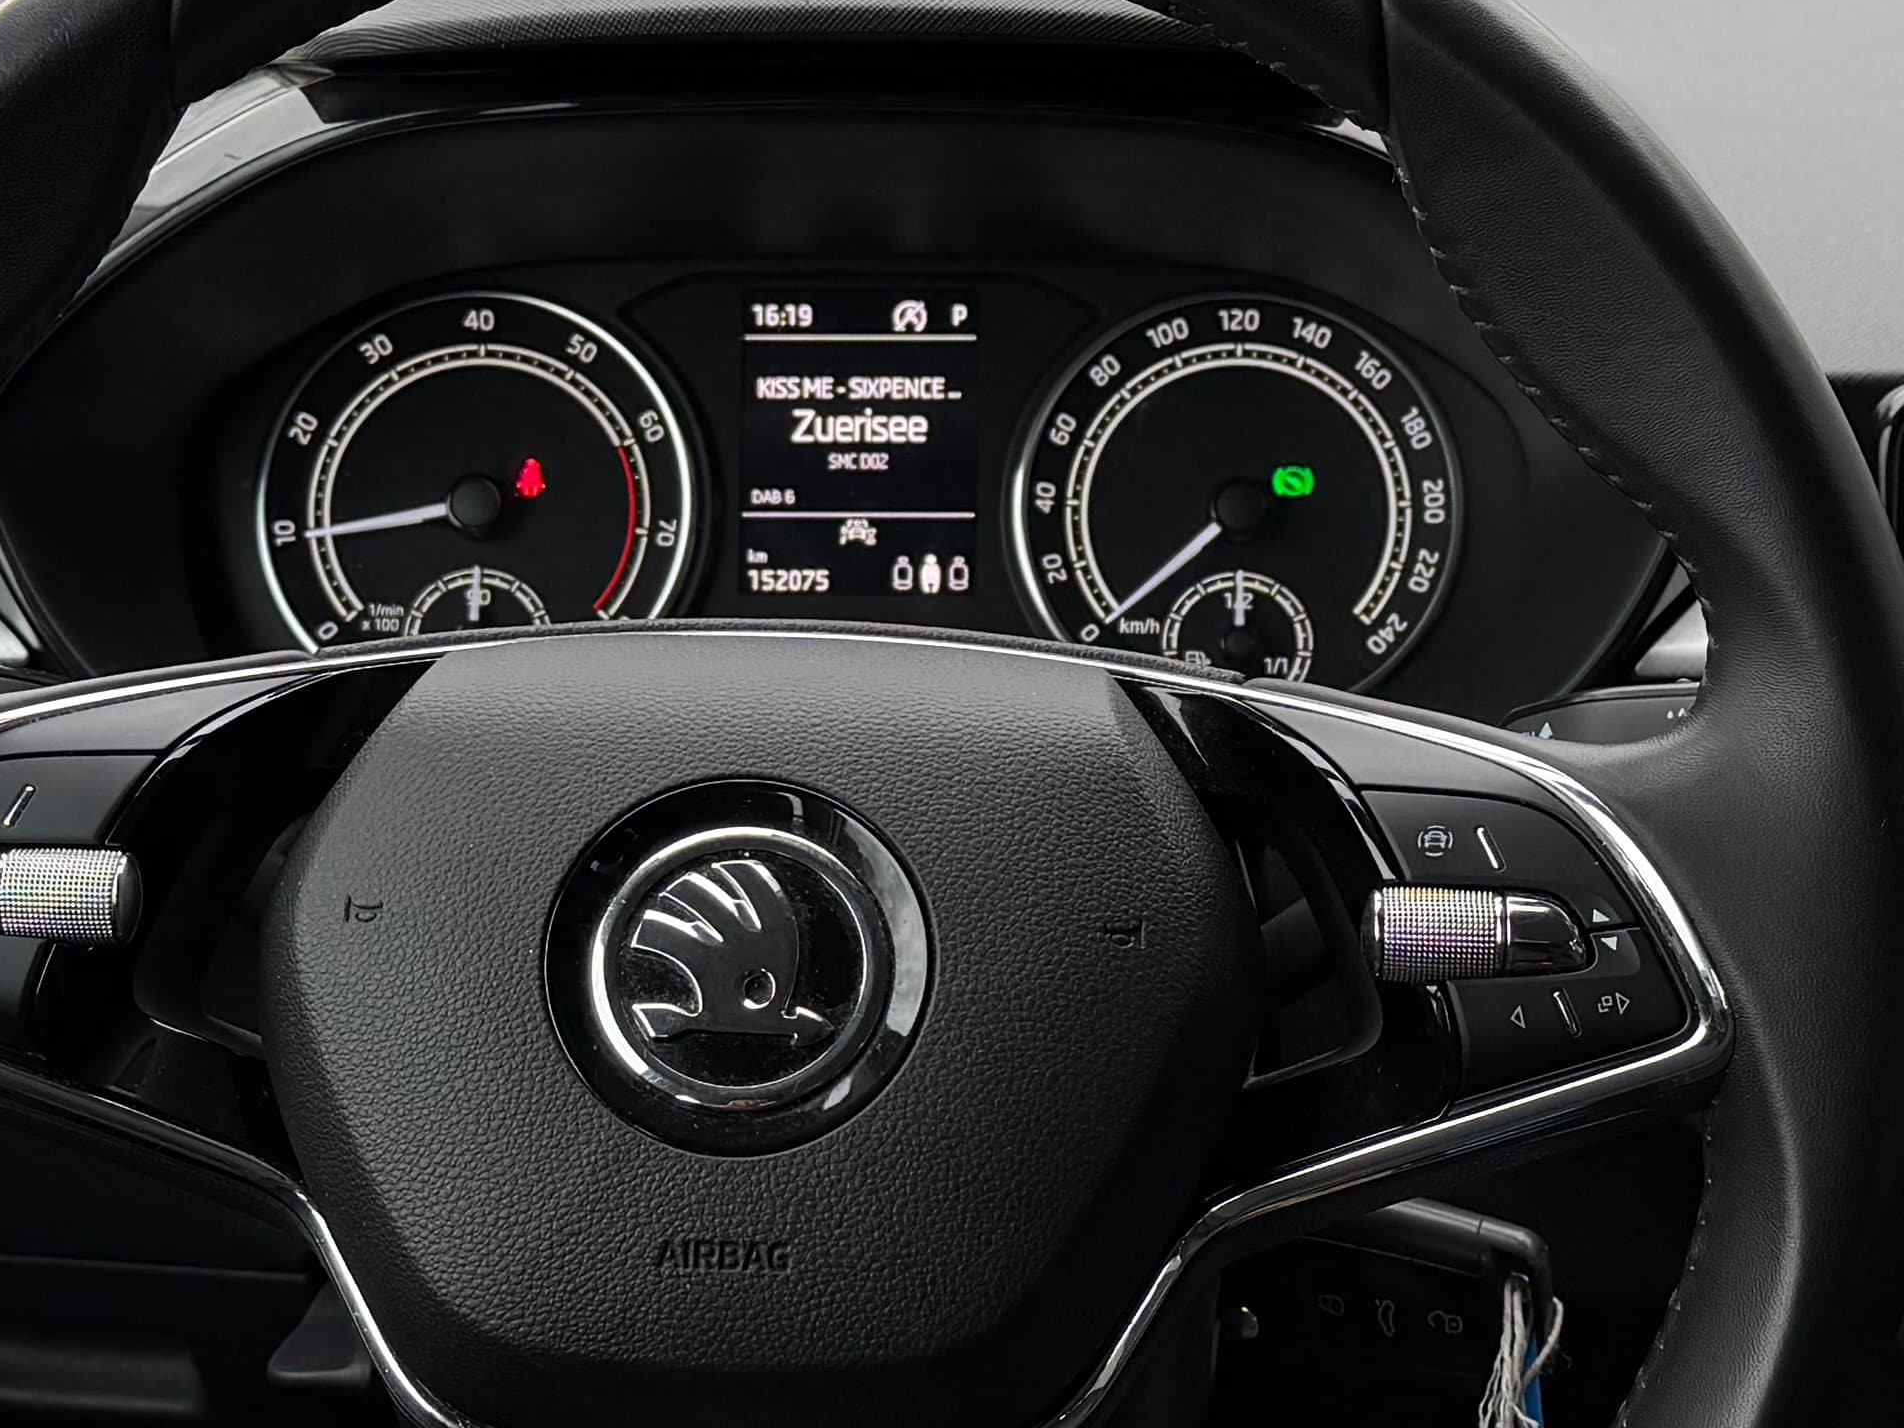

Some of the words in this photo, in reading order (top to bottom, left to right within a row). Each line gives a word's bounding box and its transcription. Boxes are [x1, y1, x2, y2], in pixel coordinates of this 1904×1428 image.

[463, 309, 495, 331] 40
[751, 303, 813, 327] 16:19
[951, 303, 968, 327] P
[1218, 308, 1260, 332] 120
[1145, 317, 1190, 349] 100
[1292, 317, 1333, 349] 140
[358, 333, 394, 364] 30
[565, 334, 598, 364] 50
[1089, 353, 1122, 388] 80
[1354, 350, 1392, 391] 160
[756, 376, 801, 400] KISS
[803, 376, 834, 400] ME
[289, 411, 319, 445] 20
[637, 410, 665, 444] 60
[791, 407, 929, 444] Zuerisee
[1049, 411, 1077, 446] 60
[1400, 406, 1432, 451] 180
[828, 453, 857, 471] SMC
[750, 489, 782, 505] DAB
[1034, 481, 1056, 514] 40
[1422, 478, 1445, 524] 200
[274, 518, 297, 545] 10
[656, 519, 678, 548] 70
[746, 549, 769, 564] km
[1041, 552, 1067, 584] 20
[1409, 547, 1440, 593] 220
[747, 569, 830, 592] 152075
[369, 603, 405, 618] 1/min
[373, 617, 400, 632] 100
[317, 622, 340, 641] 0
[1081, 623, 1101, 643] 0
[1118, 617, 1161, 636] km/h
[1366, 612, 1408, 656] 240
[655, 1239, 791, 1272] AIRBAG
